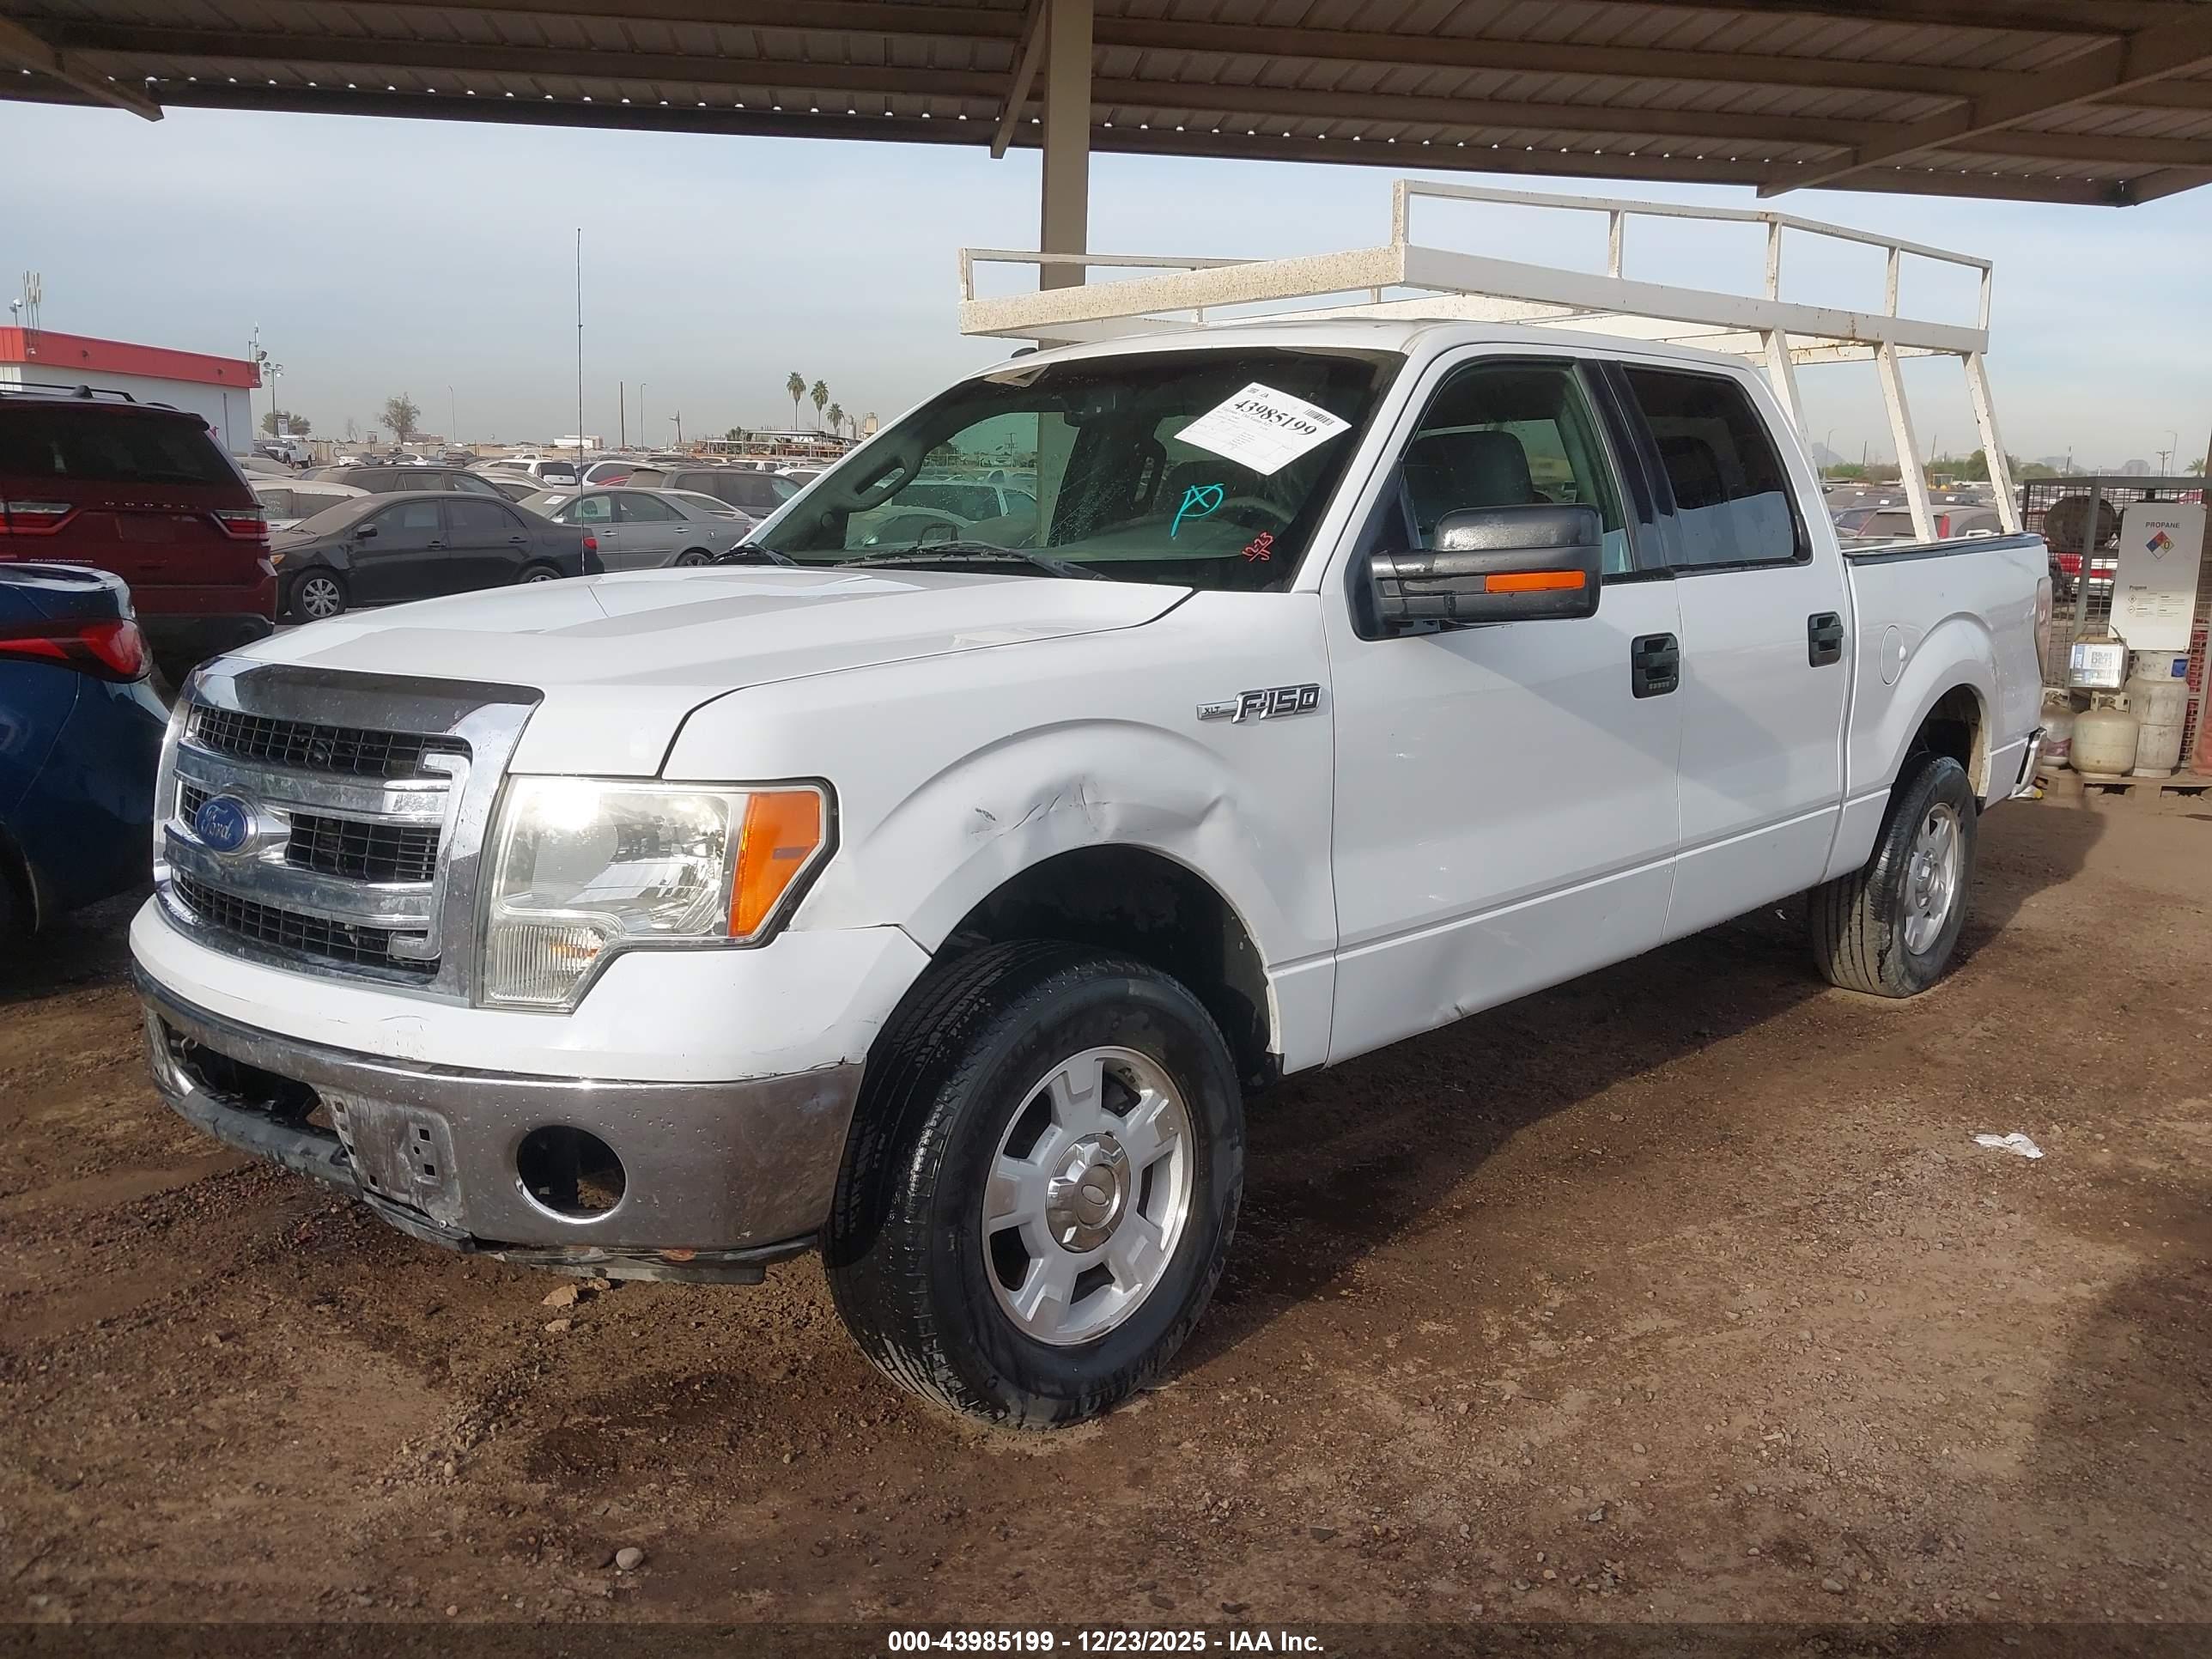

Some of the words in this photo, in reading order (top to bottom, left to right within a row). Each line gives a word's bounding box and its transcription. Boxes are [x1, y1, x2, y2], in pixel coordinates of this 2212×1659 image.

[1235, 399, 1317, 436] 43985199
[1204, 706, 1221, 715] XLT
[200, 805, 234, 840] Ford
